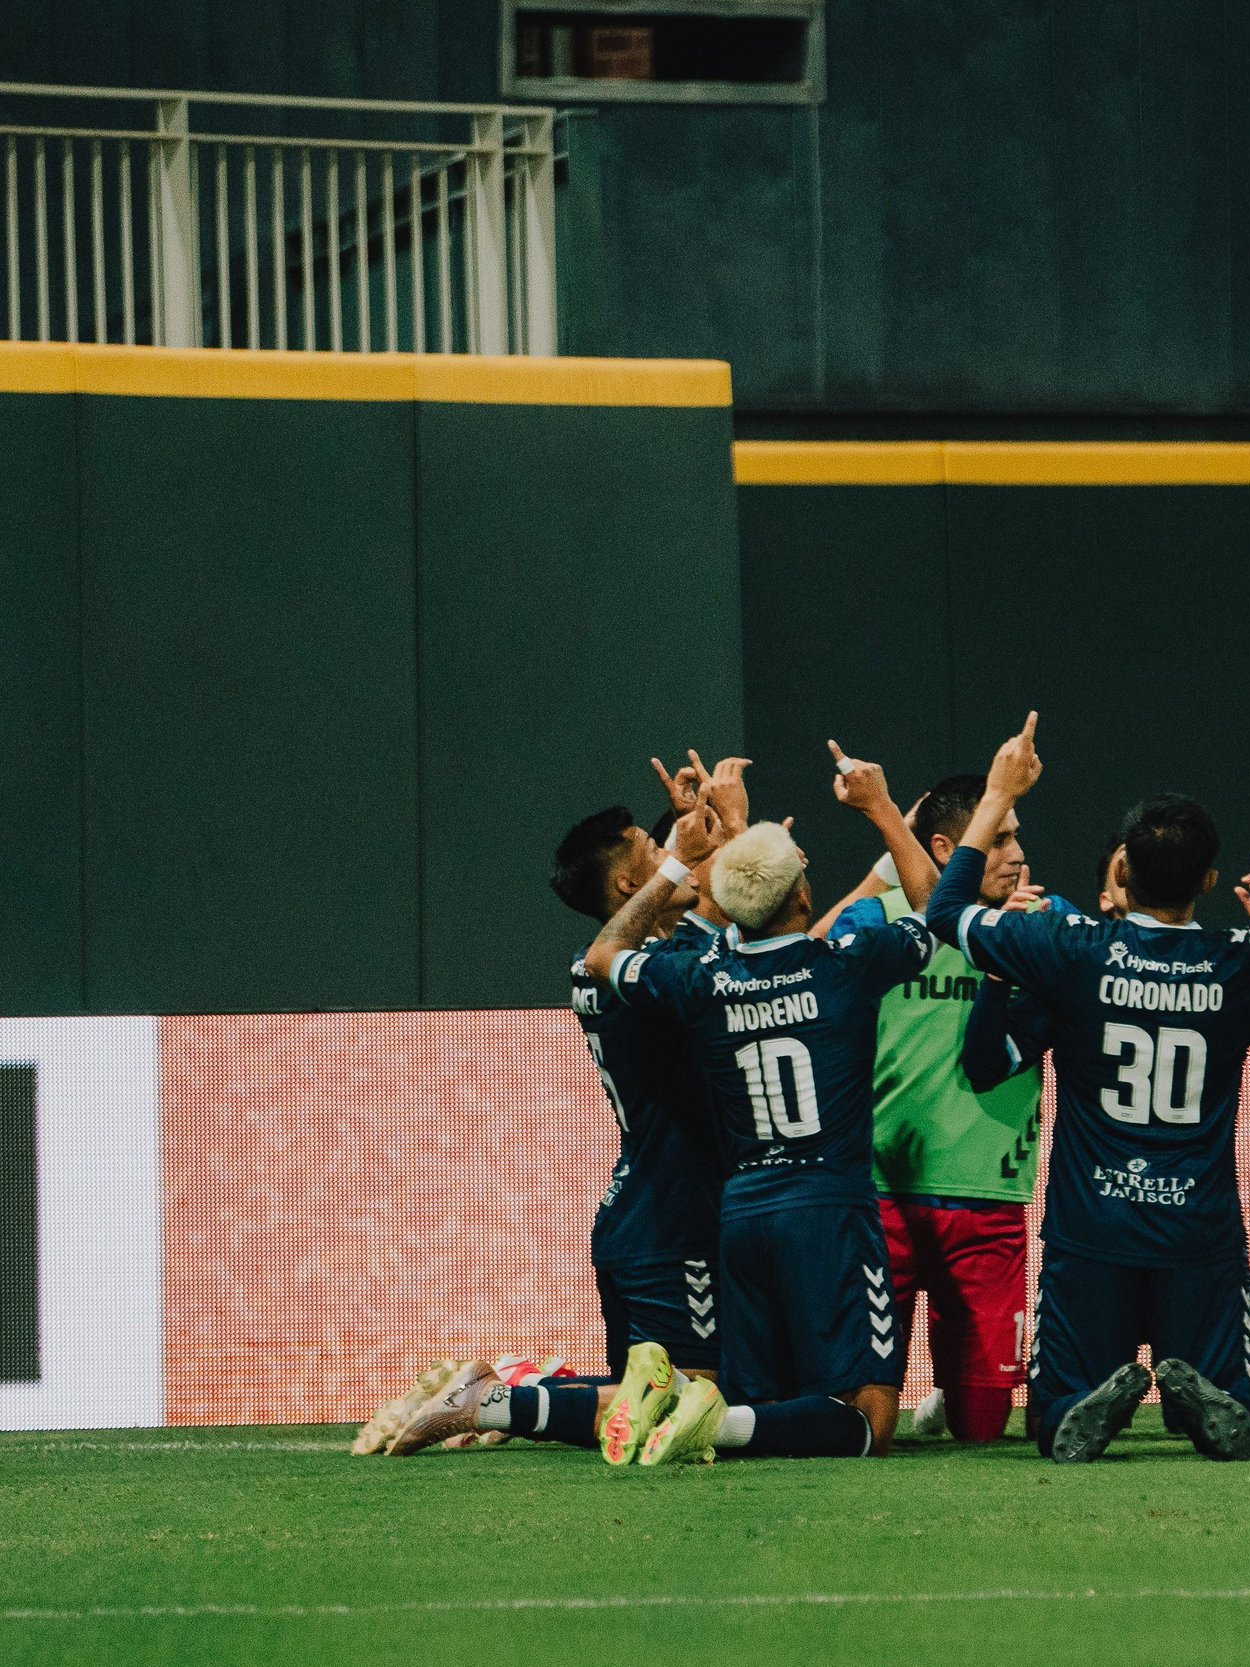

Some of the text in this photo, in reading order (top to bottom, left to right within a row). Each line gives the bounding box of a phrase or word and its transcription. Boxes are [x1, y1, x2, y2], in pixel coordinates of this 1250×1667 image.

[727, 967, 814, 996] Hydro Flask
[1126, 954, 1214, 975] Hydro Flask
[724, 991, 819, 1033] MORENO
[1099, 974, 1223, 1013] CORONADO
[735, 1036, 821, 1140] 10
[1100, 1021, 1207, 1124] 30
